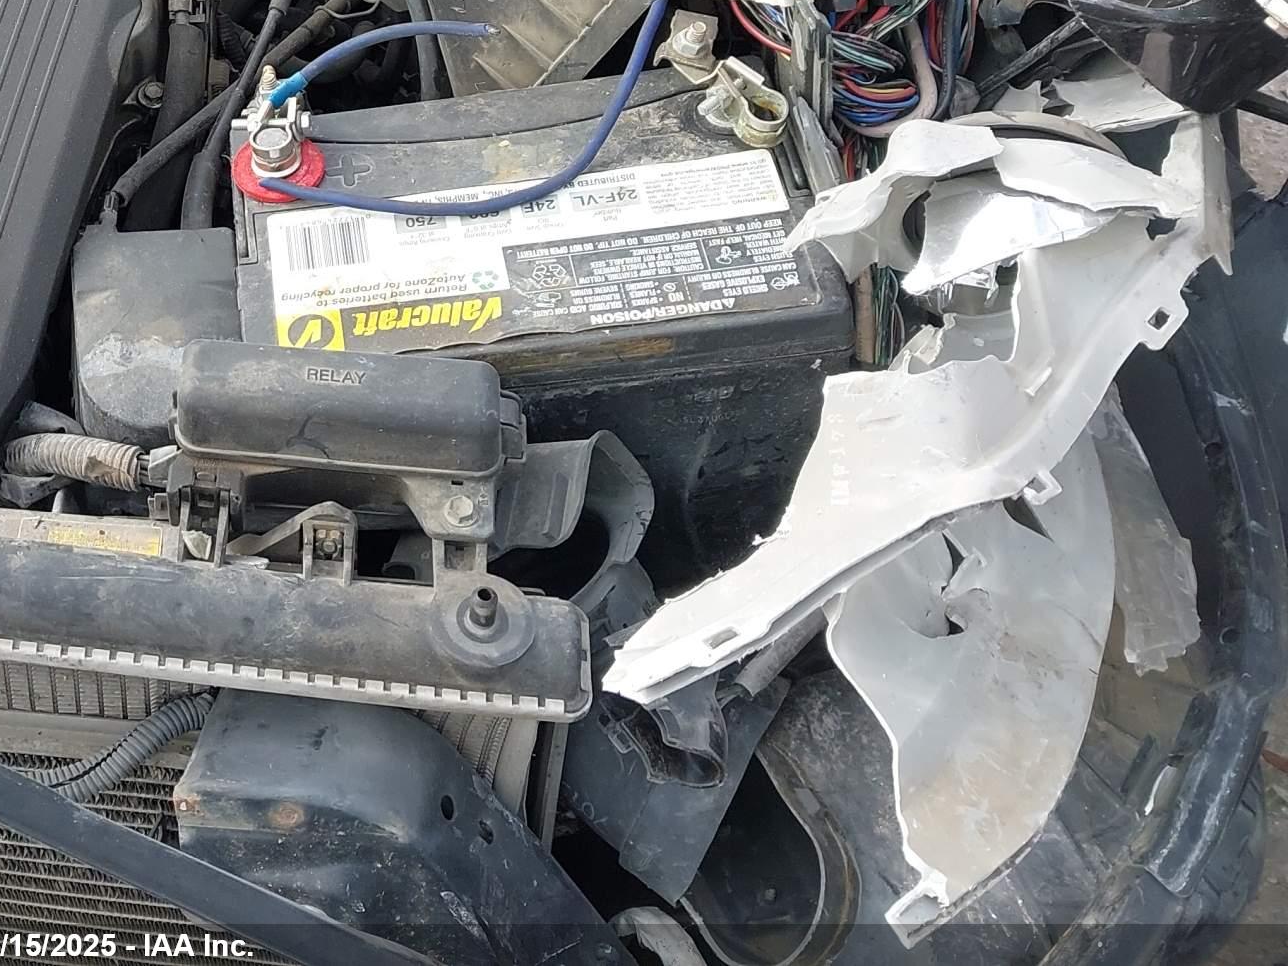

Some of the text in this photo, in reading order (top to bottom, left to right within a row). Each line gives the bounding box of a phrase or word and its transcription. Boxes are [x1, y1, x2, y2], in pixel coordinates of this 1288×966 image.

[577, 174, 637, 188] DISTRIBUTED
[573, 189, 638, 206] 24F-VL
[523, 199, 556, 214] 24F
[405, 216, 437, 228] 750
[735, 223, 747, 232] OF
[746, 221, 763, 231] OUT
[763, 218, 783, 228] KEEP
[681, 231, 692, 239] OF
[692, 227, 718, 238] REACH
[718, 226, 734, 235] THE
[626, 237, 639, 246] DO
[280, 275, 467, 303] AutoZone for proper recycling
[722, 287, 742, 297] EYES
[316, 284, 468, 308] Return used batteries to
[668, 292, 684, 302] NO
[353, 296, 503, 336] Valucraft
[590, 298, 723, 325] DANGER/POISON
[306, 367, 367, 384] RELAY
